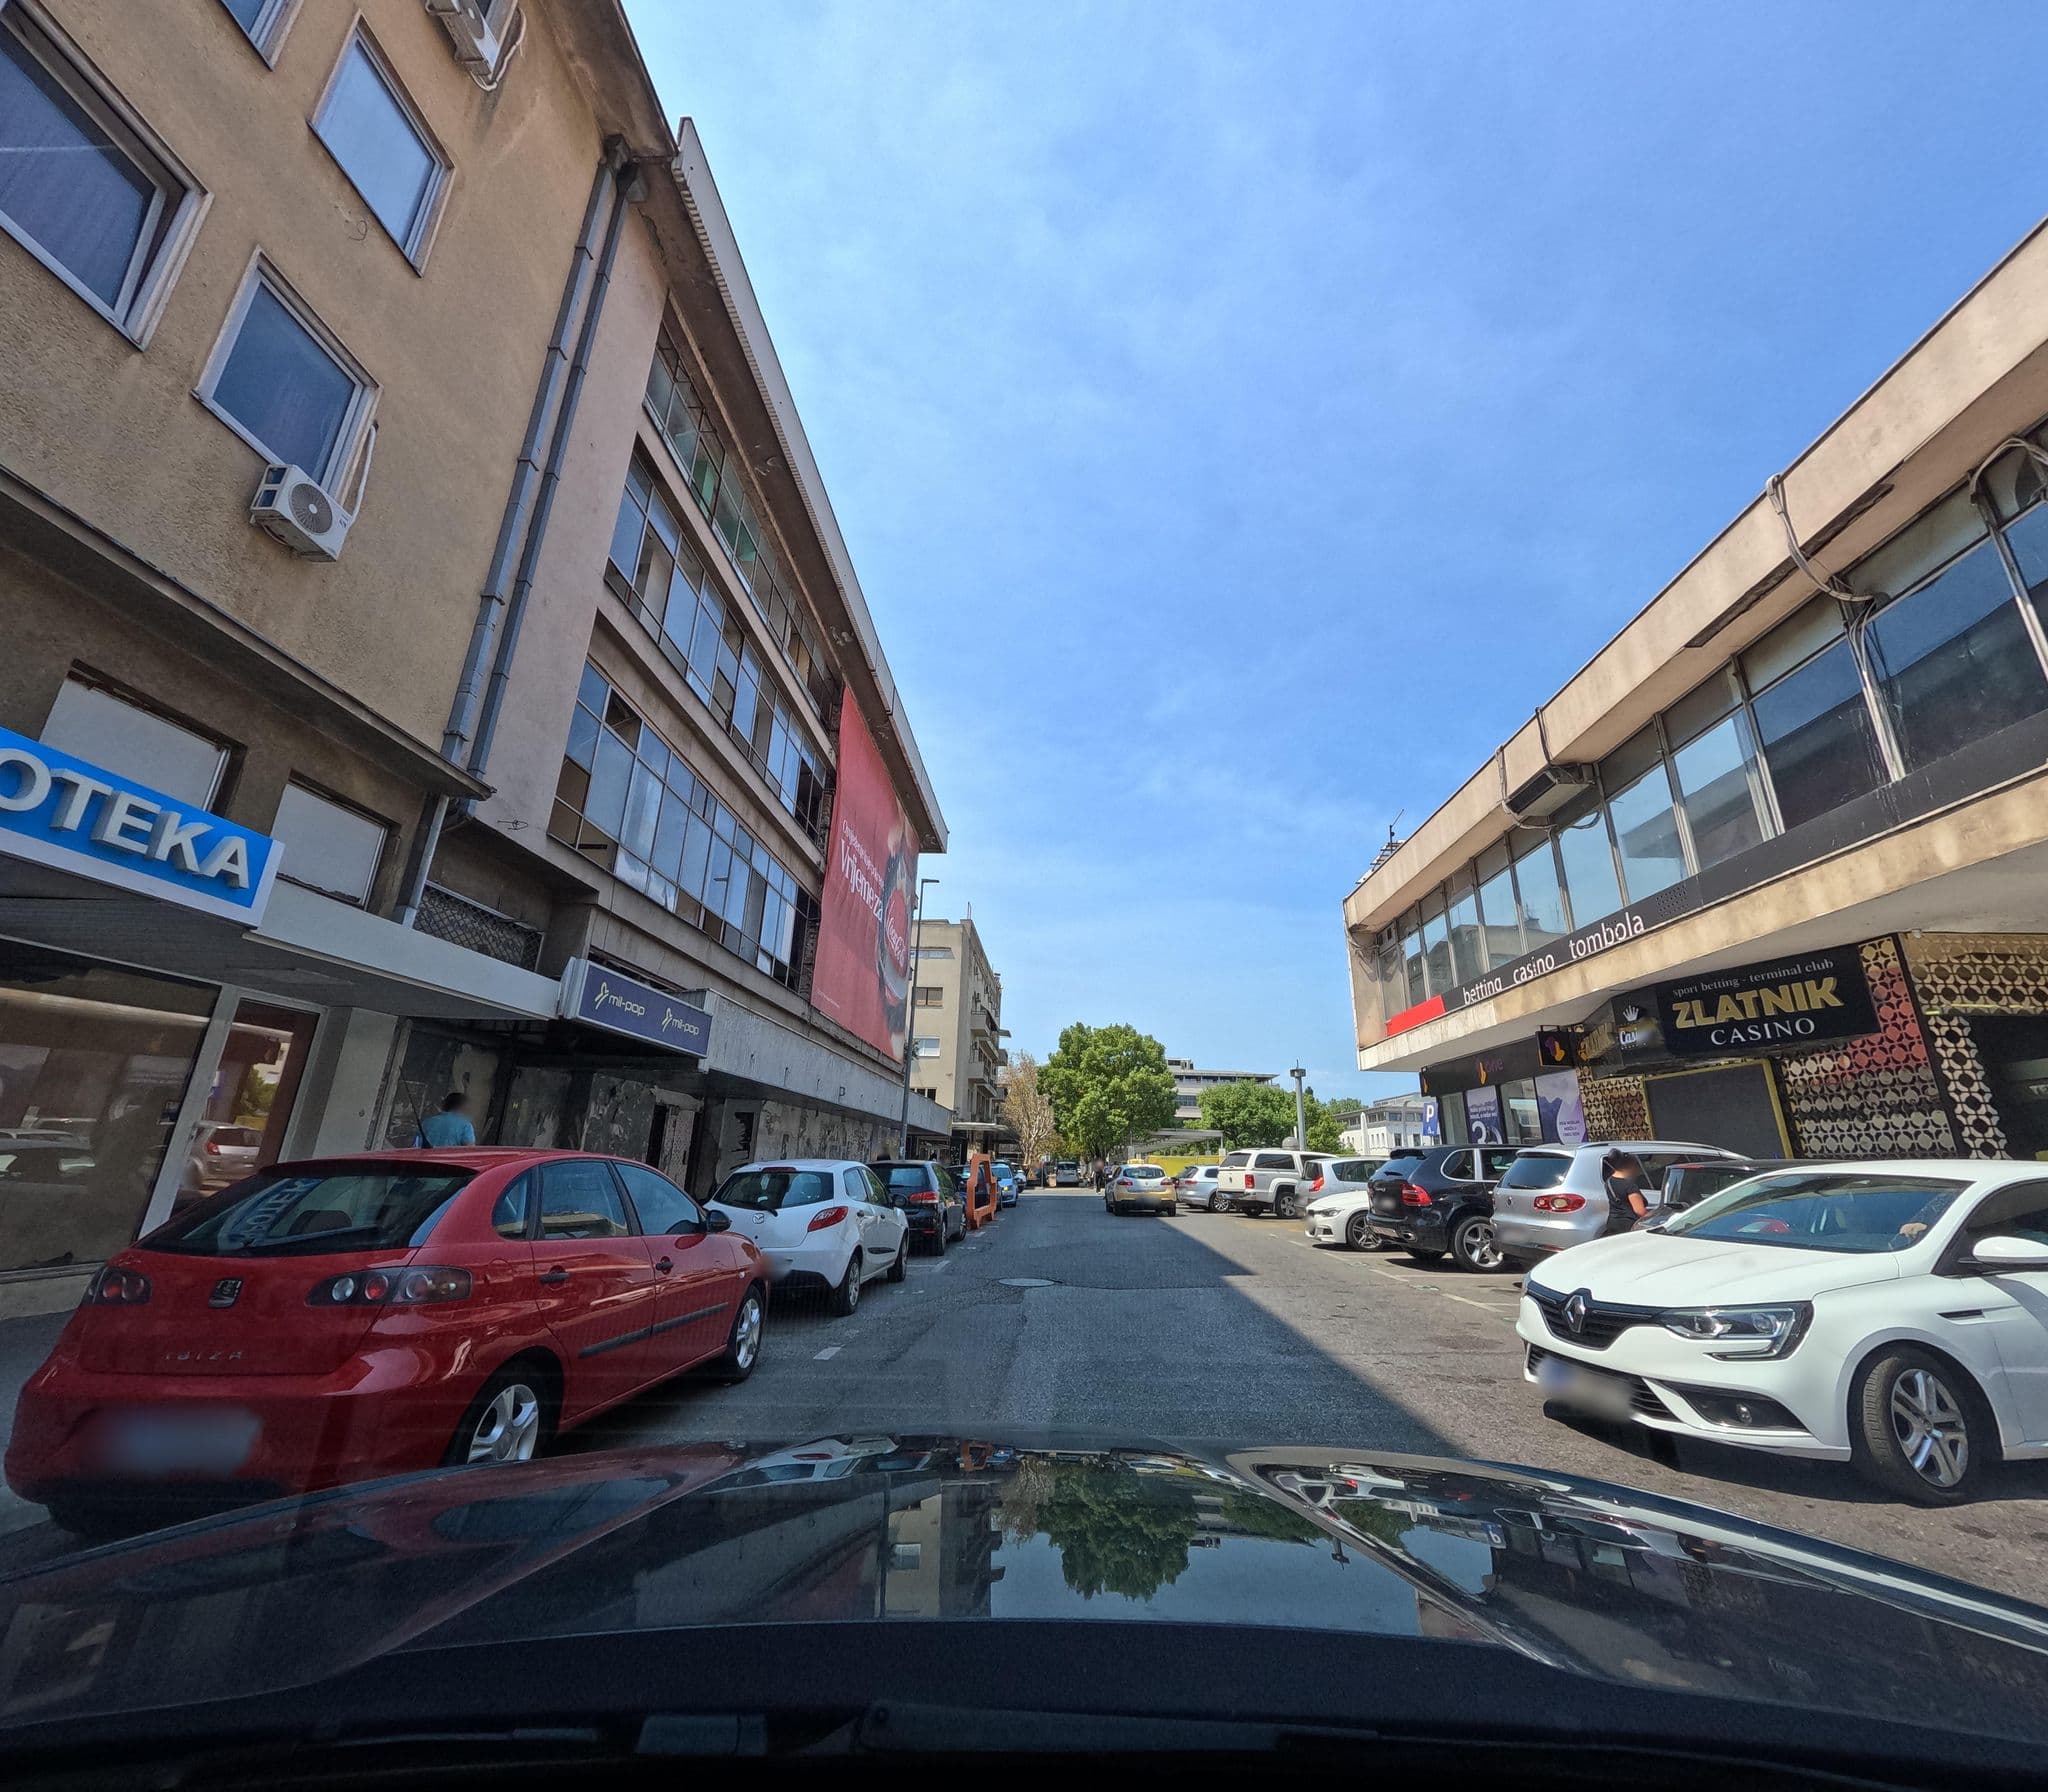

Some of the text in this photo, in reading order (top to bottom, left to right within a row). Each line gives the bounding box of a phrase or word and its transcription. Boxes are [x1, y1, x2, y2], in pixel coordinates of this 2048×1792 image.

[0, 748, 250, 889] OTEKA
[841, 839, 874, 910] Vrijeme
[1463, 911, 1645, 1005] betting casino tombola
[1672, 985, 1699, 998] sport
[1701, 977, 1740, 992] betting
[1750, 965, 1801, 983] terminal
[1805, 958, 1834, 974] club
[1672, 976, 1844, 1029] ZLATNIK
[1711, 1017, 1815, 1045] CASINO
[1426, 1104, 1435, 1123] P
